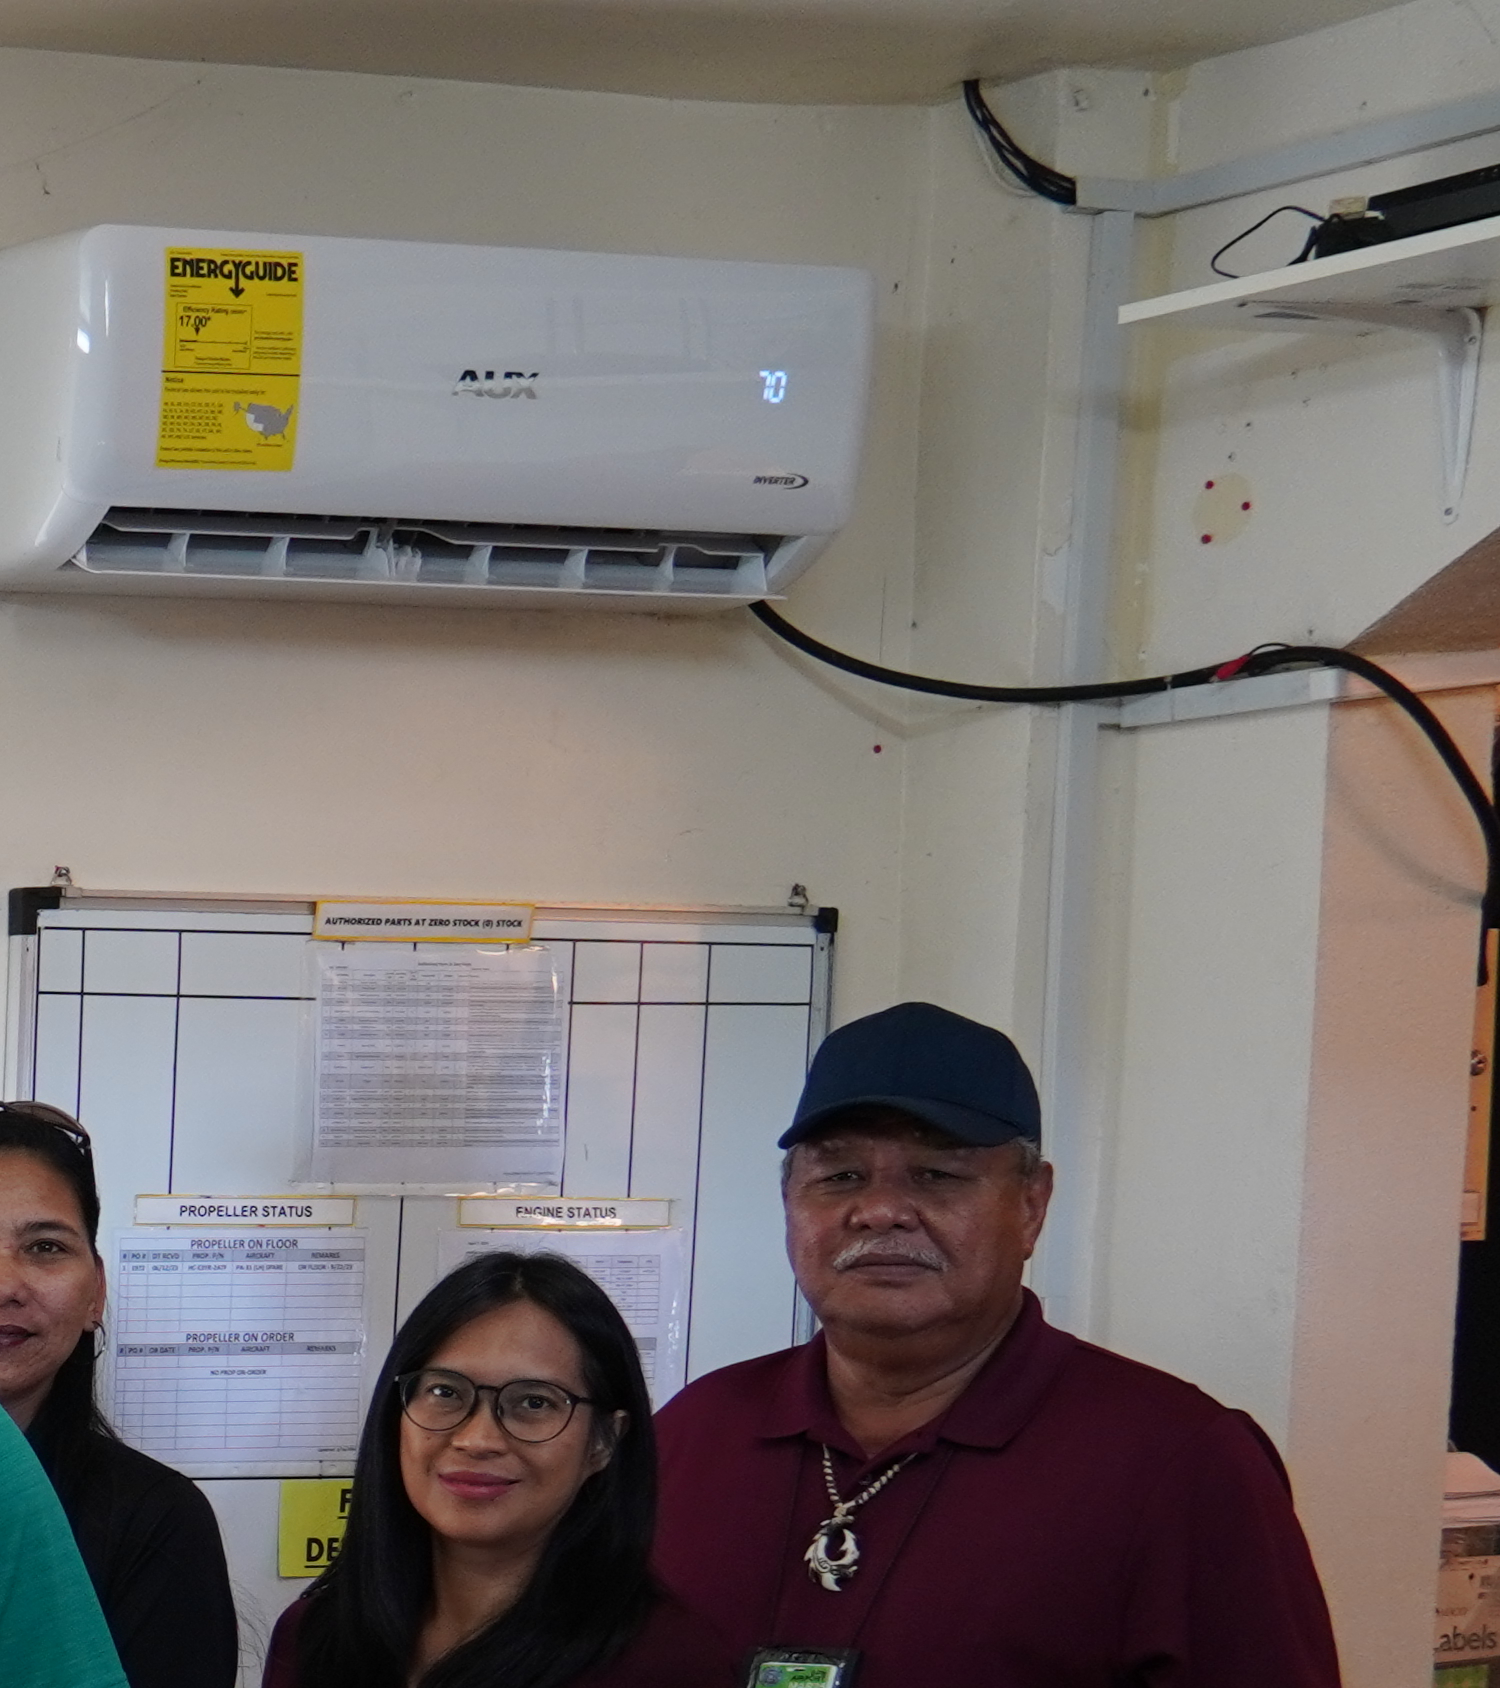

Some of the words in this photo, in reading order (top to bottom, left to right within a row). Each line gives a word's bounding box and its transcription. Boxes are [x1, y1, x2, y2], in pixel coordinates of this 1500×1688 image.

[170, 257, 298, 283] ENERGYGUIDE
[452, 369, 539, 400] AUX
[759, 370, 787, 404] 70
[753, 475, 796, 487] INVERTER
[325, 917, 382, 927] AUTHORIZED
[384, 917, 412, 926] PARTS
[414, 918, 427, 926] AT
[428, 918, 451, 927] ZERO
[452, 919, 480, 928] STOCK
[495, 919, 523, 928] STOCK
[179, 1205, 258, 1218] PROPELLER
[261, 1206, 313, 1218] STATUS
[567, 1207, 617, 1218] STATUS
[190, 1239, 246, 1249] PROPELLER
[248, 1239, 263, 1249] ON
[266, 1239, 299, 1249] FLOOR
[186, 1333, 240, 1343] PROPELLER
[243, 1333, 258, 1342] ON
[261, 1332, 295, 1342] ORDER
